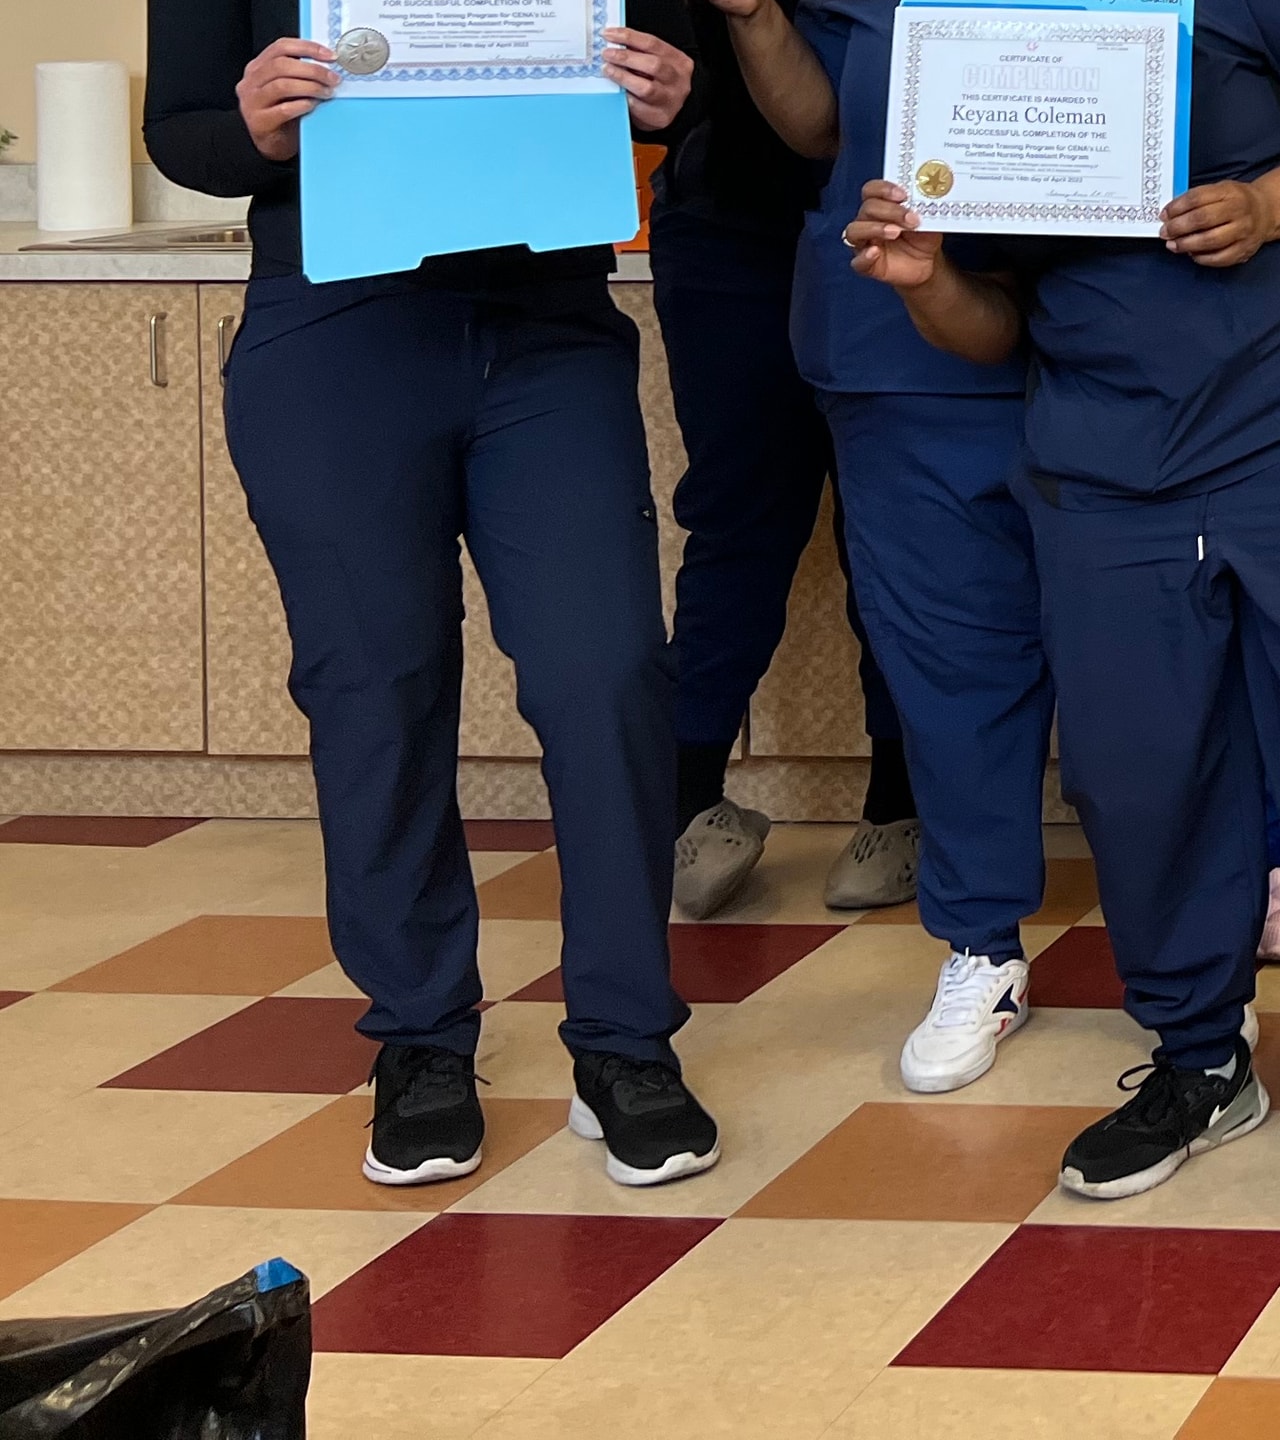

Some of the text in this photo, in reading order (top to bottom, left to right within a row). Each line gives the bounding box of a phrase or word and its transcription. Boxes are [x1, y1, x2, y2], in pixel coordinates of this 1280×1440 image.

[1000, 55, 1049, 63] CERTIFICATE
[963, 64, 1099, 91] COMPLETION
[982, 94, 1032, 103] CERTIFICATE
[1043, 96, 1084, 104] AWARDED
[952, 105, 1106, 125] Keyana Coleman
[967, 129, 1020, 137] SUCCESSFUL
[1023, 130, 1076, 138] COMPLETION
[1026, 144, 1054, 152] Program
[1059, 153, 1089, 161] Program
